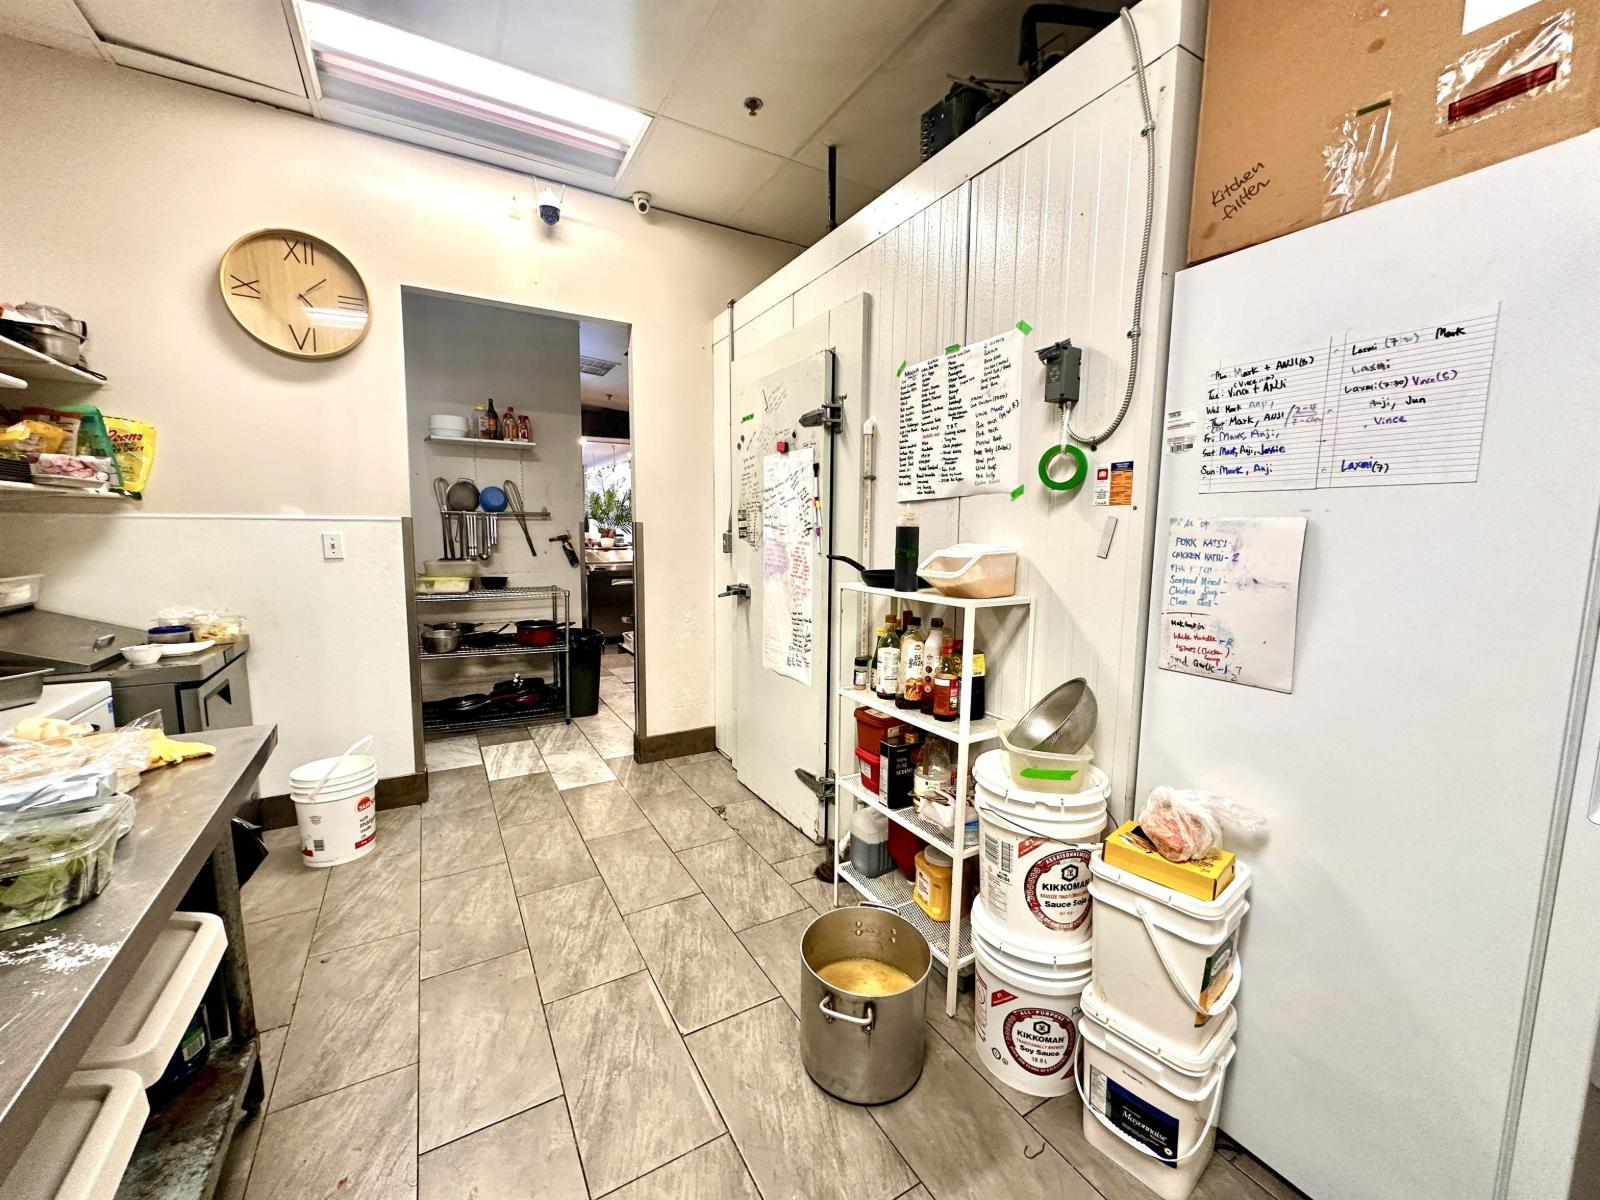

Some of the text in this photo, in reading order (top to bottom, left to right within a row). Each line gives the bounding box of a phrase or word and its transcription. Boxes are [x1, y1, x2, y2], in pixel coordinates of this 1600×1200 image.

[1212, 162, 1265, 207] Kitchen
[282, 236, 314, 266] XII
[289, 324, 316, 352] VI
[1405, 395, 1426, 405] Jun
[1374, 415, 1407, 425] Vince
[1175, 537, 1197, 548] PORK
[1171, 550, 1201, 560] CHICKEN
[1041, 879, 1090, 892] KIKKOMAN
[1044, 897, 1087, 908] Sauce Soja
[1016, 1029, 1065, 1044] KIKKOMAN
[1019, 1045, 1060, 1057] Soy Sauce
[1122, 1110, 1167, 1142] Mayonnaise
